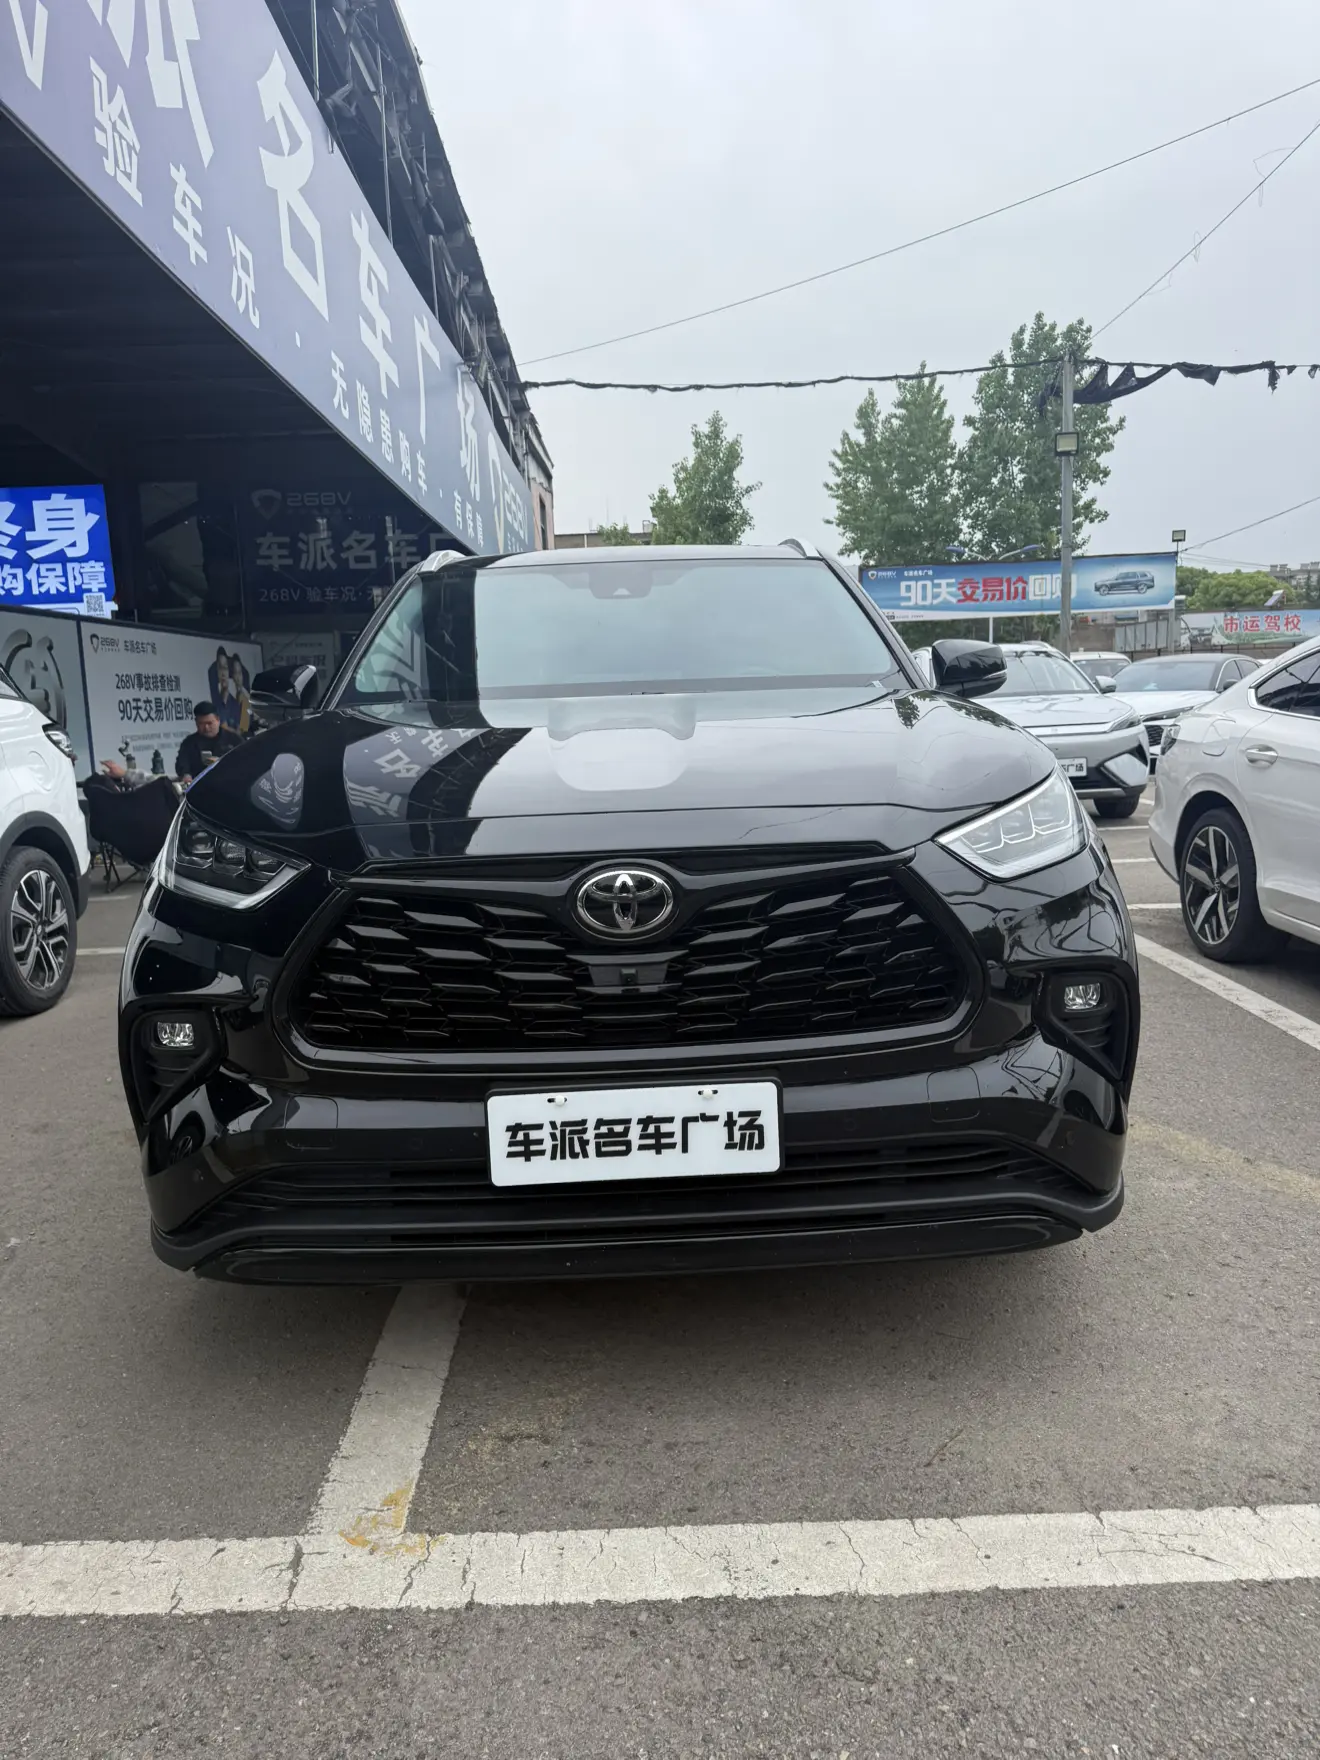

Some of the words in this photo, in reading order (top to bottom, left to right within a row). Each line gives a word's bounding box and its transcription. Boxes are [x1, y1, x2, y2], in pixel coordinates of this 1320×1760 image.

[286, 491, 352, 507] 268V
[259, 588, 300, 603] 268V
[1223, 614, 1301, 633] 市运驾校
[115, 673, 181, 693] 268V事故排查检测
[118, 697, 194, 723] 90天交易价回购
[505, 1110, 765, 1162] 车派名车广场
